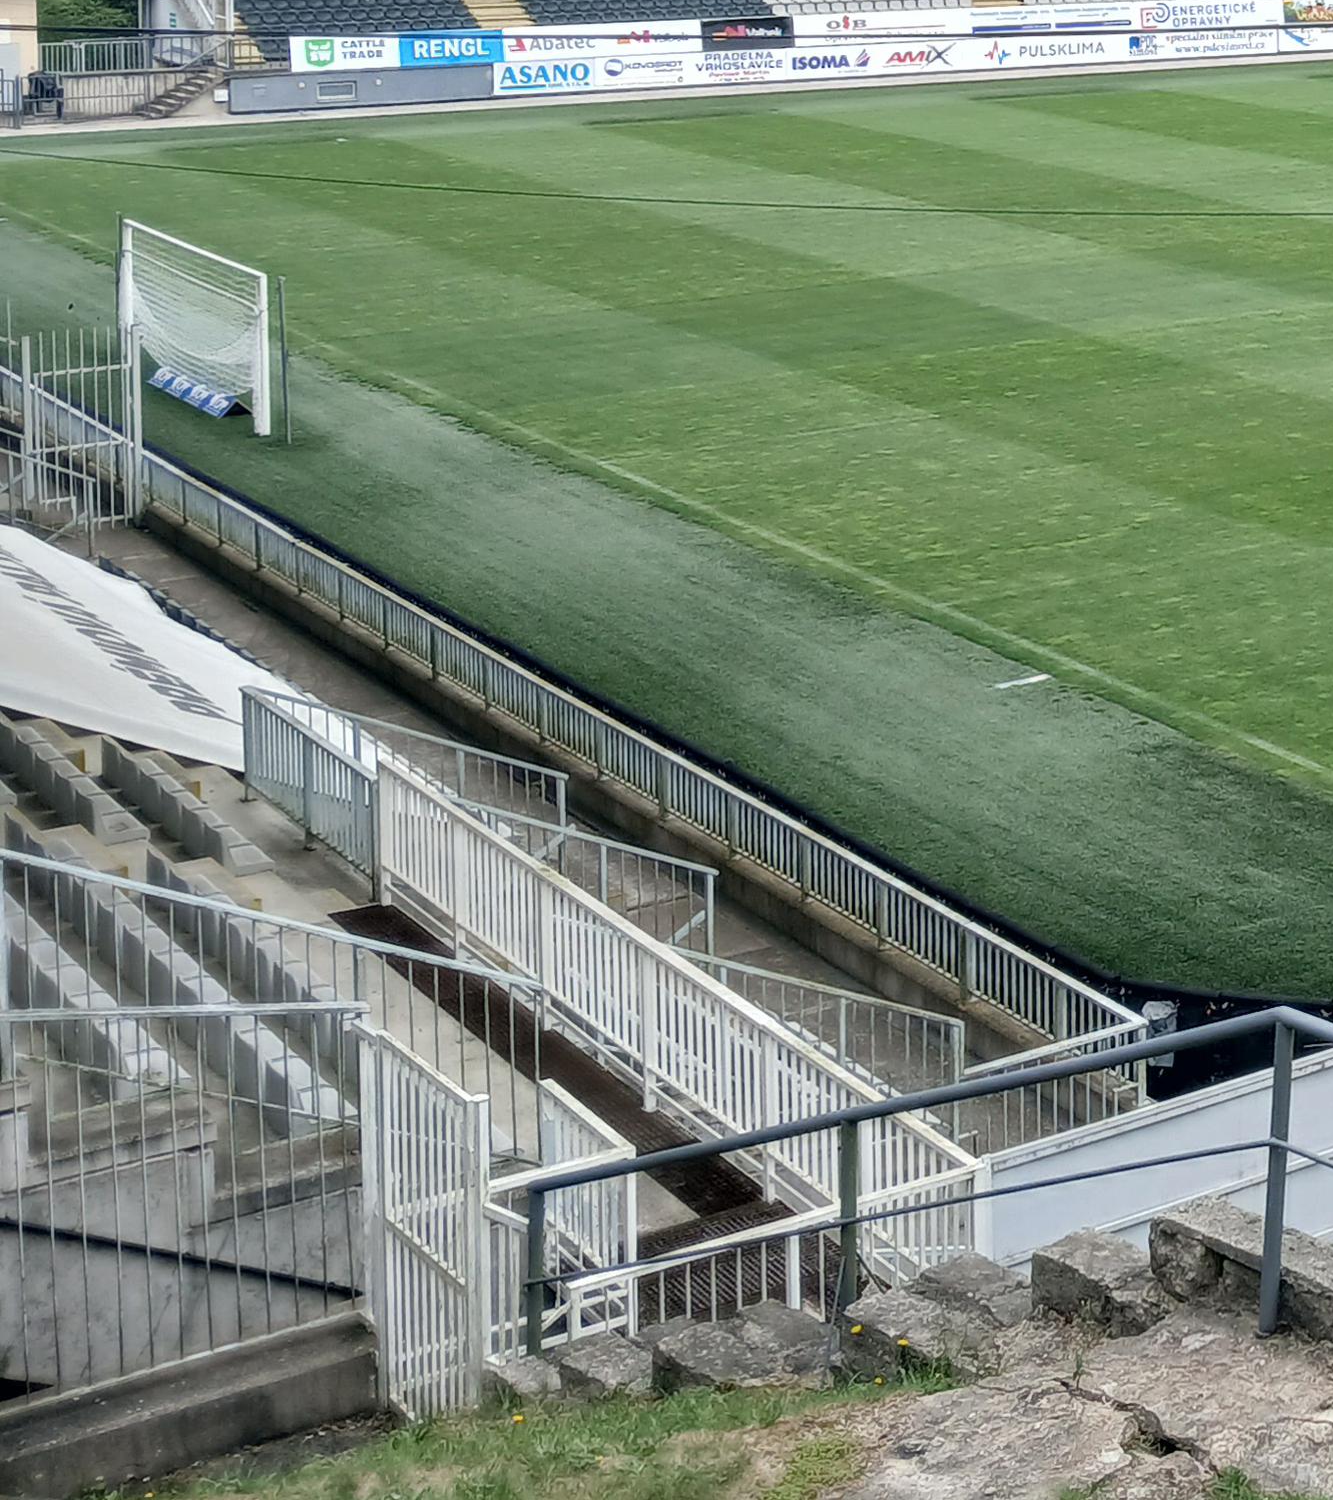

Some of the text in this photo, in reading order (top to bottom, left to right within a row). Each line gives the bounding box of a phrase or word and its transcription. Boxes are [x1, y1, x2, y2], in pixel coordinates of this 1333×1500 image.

[1172, 1, 1256, 17] ENERGETICKÉ
[1172, 16, 1232, 28] OPRAVNY
[341, 39, 385, 49] CATTLE
[413, 38, 490, 59] RENGL
[1018, 41, 1106, 58] PULSKLIMA
[341, 50, 383, 60] TRADE
[791, 53, 851, 71] ISOMA
[884, 42, 957, 68] AMIX
[500, 62, 590, 85] ASANO
